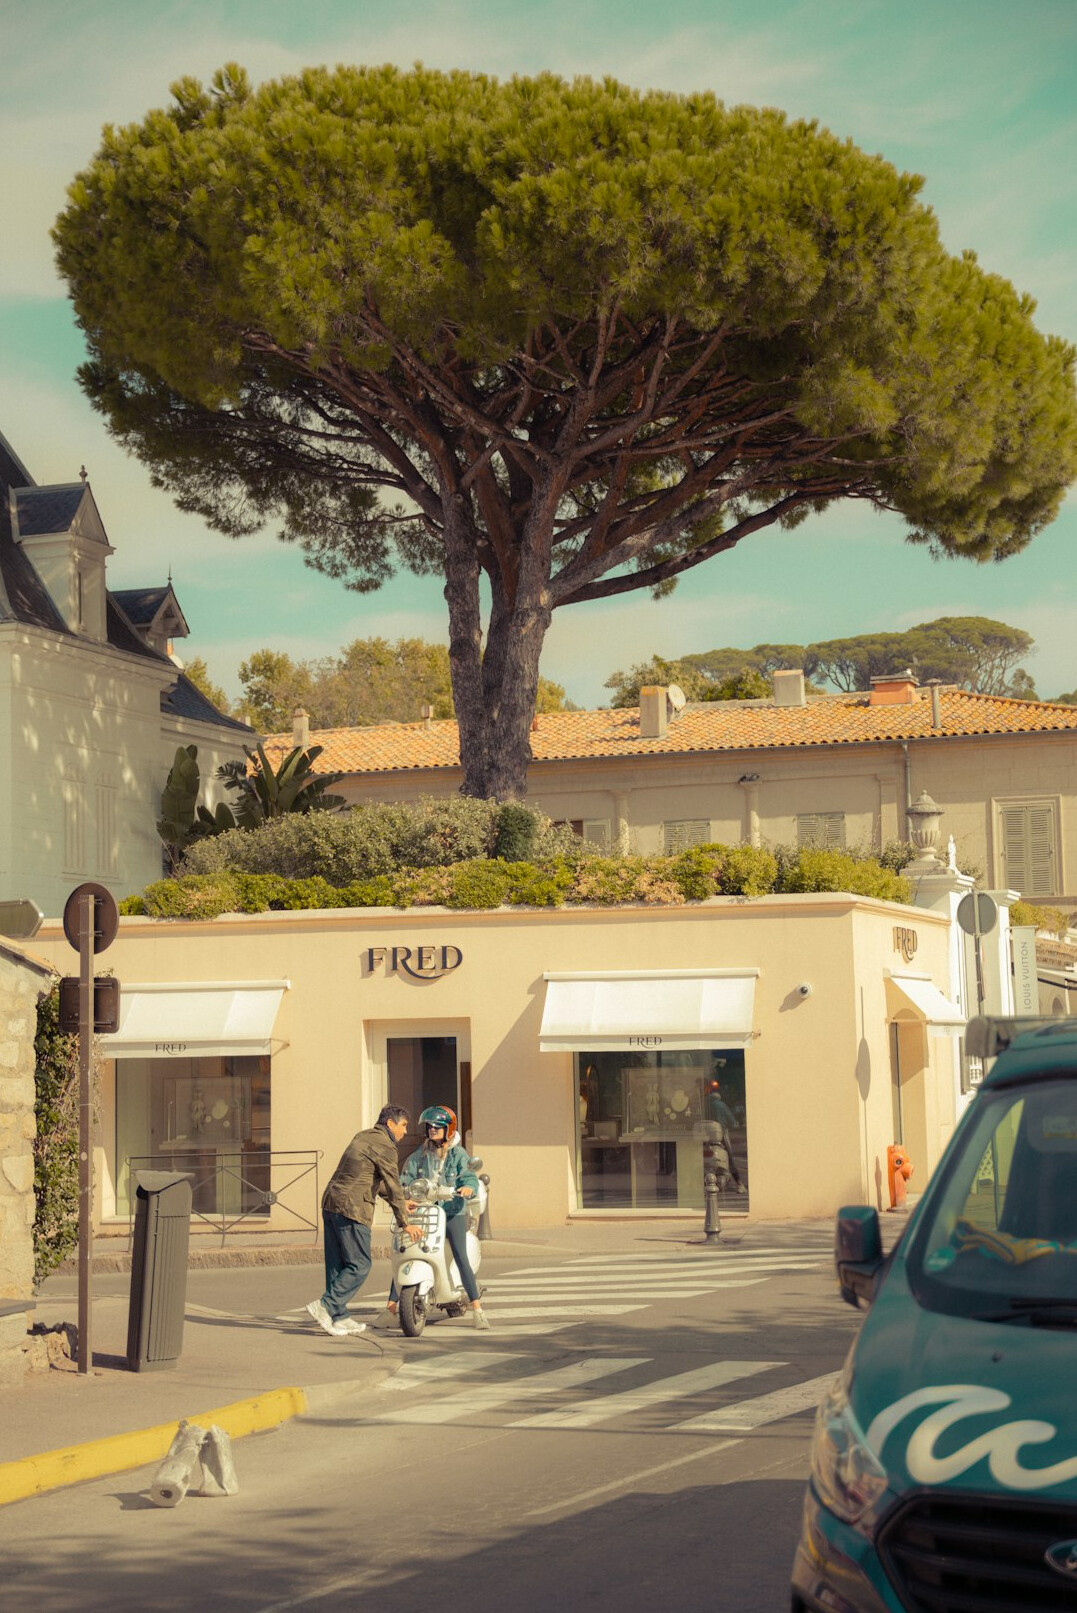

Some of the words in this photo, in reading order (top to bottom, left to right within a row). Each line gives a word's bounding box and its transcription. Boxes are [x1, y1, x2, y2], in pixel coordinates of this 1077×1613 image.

[367, 945, 463, 980] FRED
[1020, 941, 1030, 980] VUITTON
[1023, 983, 1032, 1009] LOUIS
[155, 1043, 187, 1055] FRED
[629, 1036, 662, 1049] FRED
